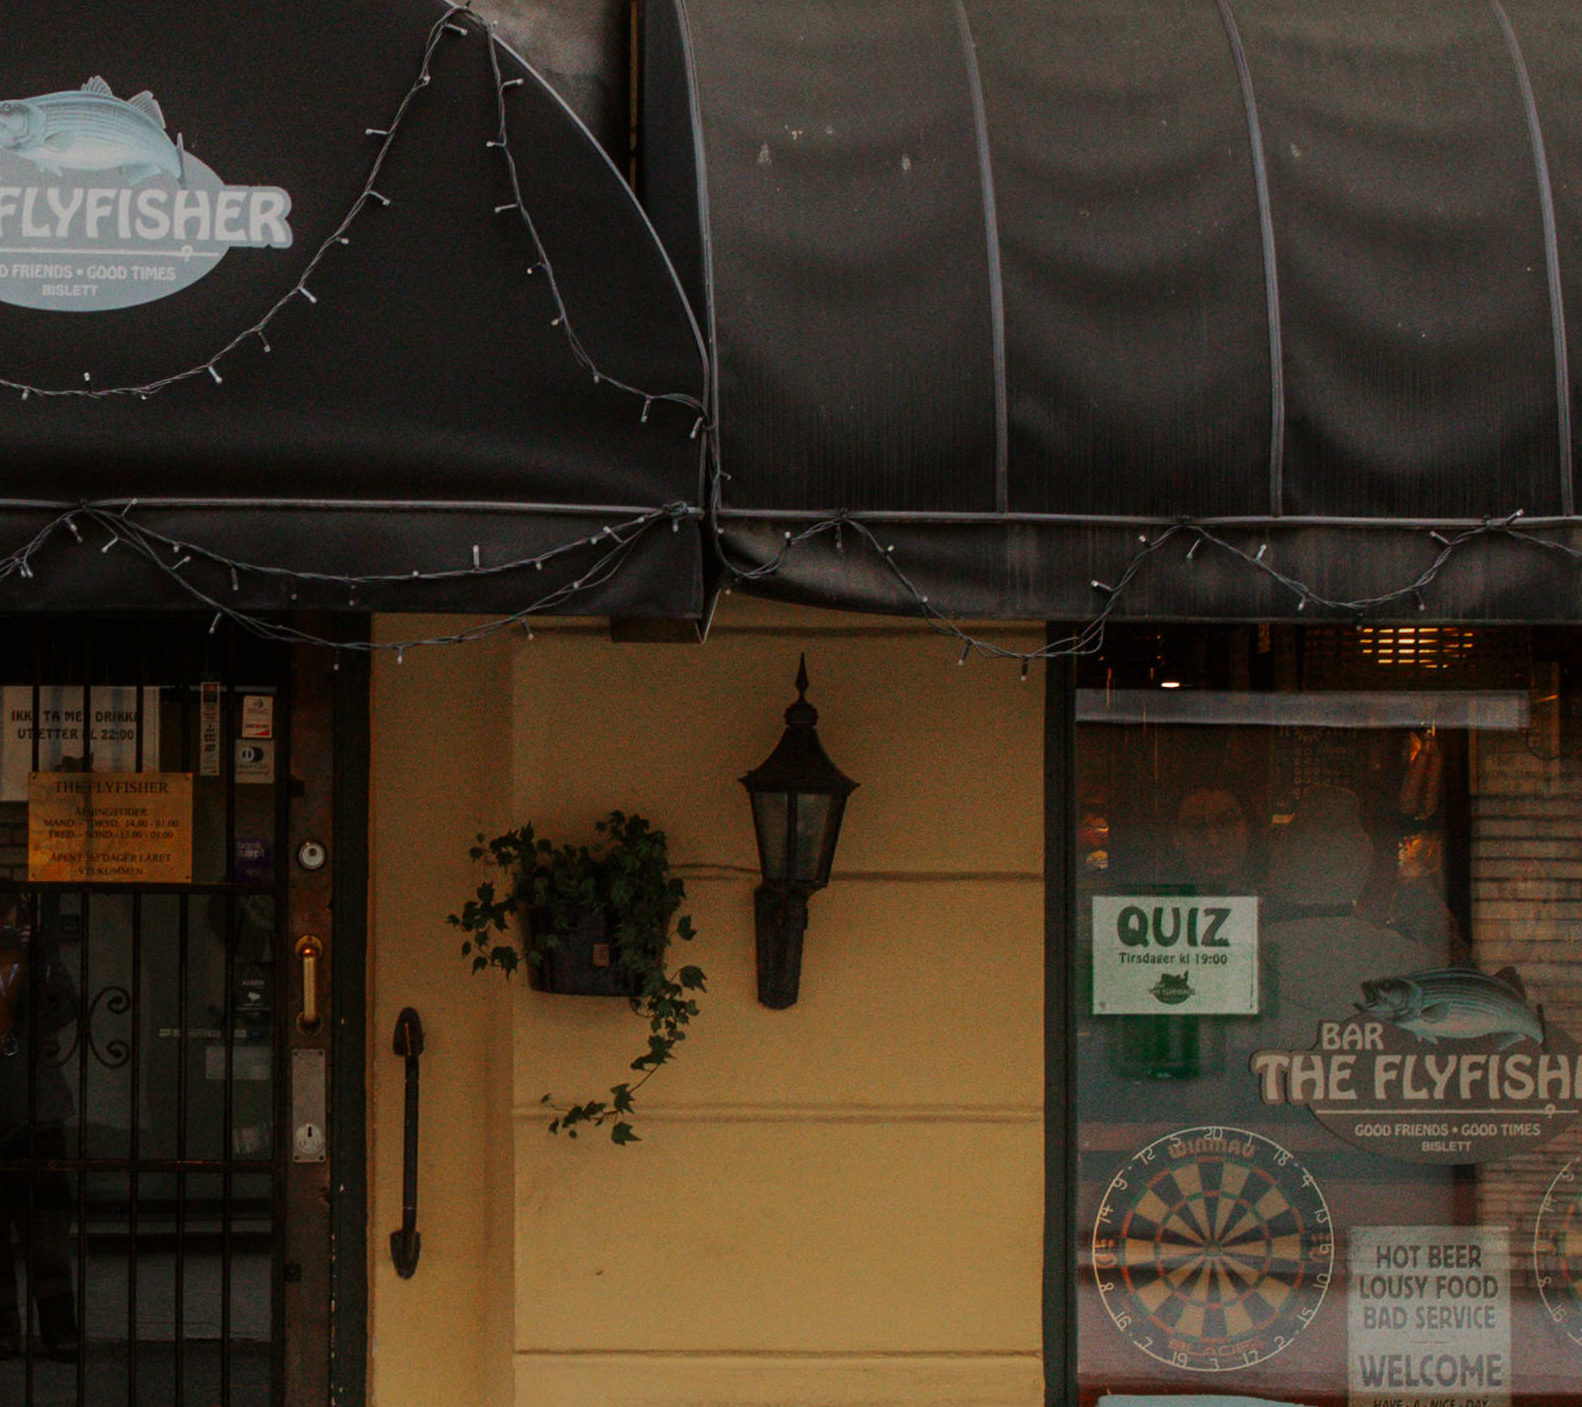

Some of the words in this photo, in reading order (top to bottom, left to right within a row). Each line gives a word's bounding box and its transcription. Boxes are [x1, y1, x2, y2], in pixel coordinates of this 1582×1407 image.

[13, 265, 73, 280] FRIENDS
[87, 266, 129, 280] GOOD
[131, 267, 176, 281] TIMES
[42, 285, 98, 297] BISLETT
[11, 710, 37, 722] IKK
[43, 710, 61, 722] TA
[64, 710, 84, 723] ME
[100, 729, 135, 741] 22:00
[55, 781, 86, 794] THE
[88, 781, 169, 794] FLYFISHER
[1116, 906, 1233, 947] QUIZ
[1118, 952, 1176, 965] Tirsdager
[1178, 953, 1191, 965] kl
[1195, 953, 1228, 965] 19:00
[1322, 1022, 1384, 1051] BAR
[1255, 1055, 1357, 1099] THE
[1355, 1123, 1392, 1137] GOOD
[1394, 1123, 1449, 1136] FRIENDS
[1461, 1123, 1499, 1137] GOOD
[1500, 1123, 1541, 1136] TIMES
[1421, 1140, 1472, 1152] BISLETT
[1376, 1245, 1421, 1269] HOT
[1427, 1245, 1482, 1269] BEER
[1358, 1275, 1429, 1299] LOUSY
[1435, 1275, 1499, 1299] FOOD
[1363, 1305, 1408, 1330] BAD
[1415, 1305, 1497, 1330] SERVICE
[1358, 1354, 1503, 1387] WELCOME
